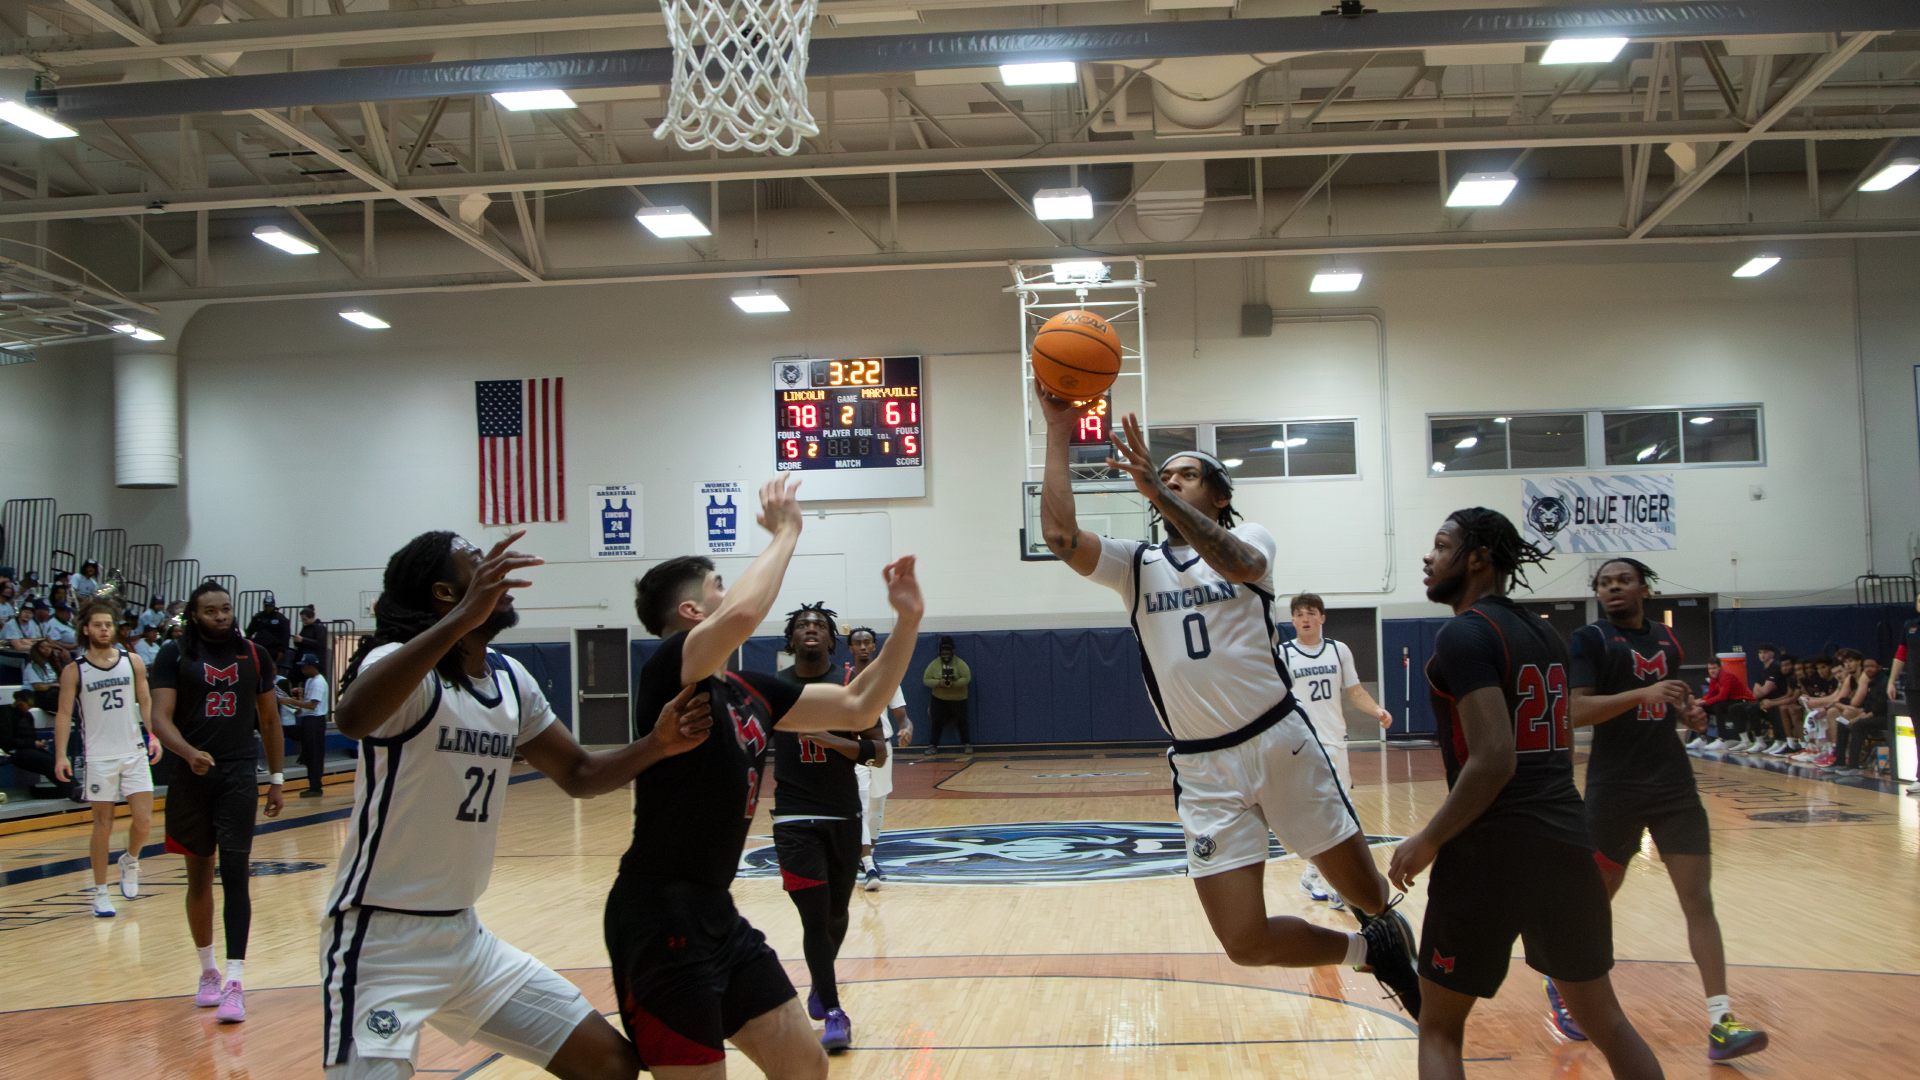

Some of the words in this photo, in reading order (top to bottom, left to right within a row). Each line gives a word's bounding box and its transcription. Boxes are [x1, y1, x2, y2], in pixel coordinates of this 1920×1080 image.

[1063, 314, 1108, 336] NCAA
[829, 360, 880, 385] 3:22
[783, 390, 825, 401] LINCOLN
[837, 395, 858, 403] GAME
[861, 387, 918, 398] MARYVILLE
[788, 405, 817, 428] 78
[841, 405, 854, 425] 2
[885, 401, 916, 425] 61
[777, 431, 801, 439] FOULS
[823, 429, 850, 438] PLAYER
[854, 428, 873, 437] FOUL
[895, 427, 919, 435] FOULS
[1080, 415, 1102, 440] 19
[786, 440, 798, 458] 5
[808, 443, 818, 457] 2
[883, 441, 890, 453] 1
[904, 436, 917, 454] 5
[778, 462, 802, 470] SCORE
[835, 459, 861, 468] MATCH
[896, 457, 920, 465] SCORE
[1575, 496, 1618, 525] BLUE
[1622, 494, 1670, 523] TIGER
[610, 520, 623, 531] 24
[715, 517, 727, 528] 41
[1575, 527, 1637, 536] ATHLETICS
[1642, 526, 1671, 534] CLUB
[1144, 581, 1238, 615] LINCOLN
[1182, 612, 1211, 660] 0
[1293, 664, 1338, 678] LINCOLN
[85, 676, 131, 692] LINCOLN
[1308, 679, 1332, 702] 20
[100, 688, 125, 711] 25
[205, 691, 237, 717] 23
[1515, 663, 1569, 753] 22
[455, 766, 497, 823] 21
